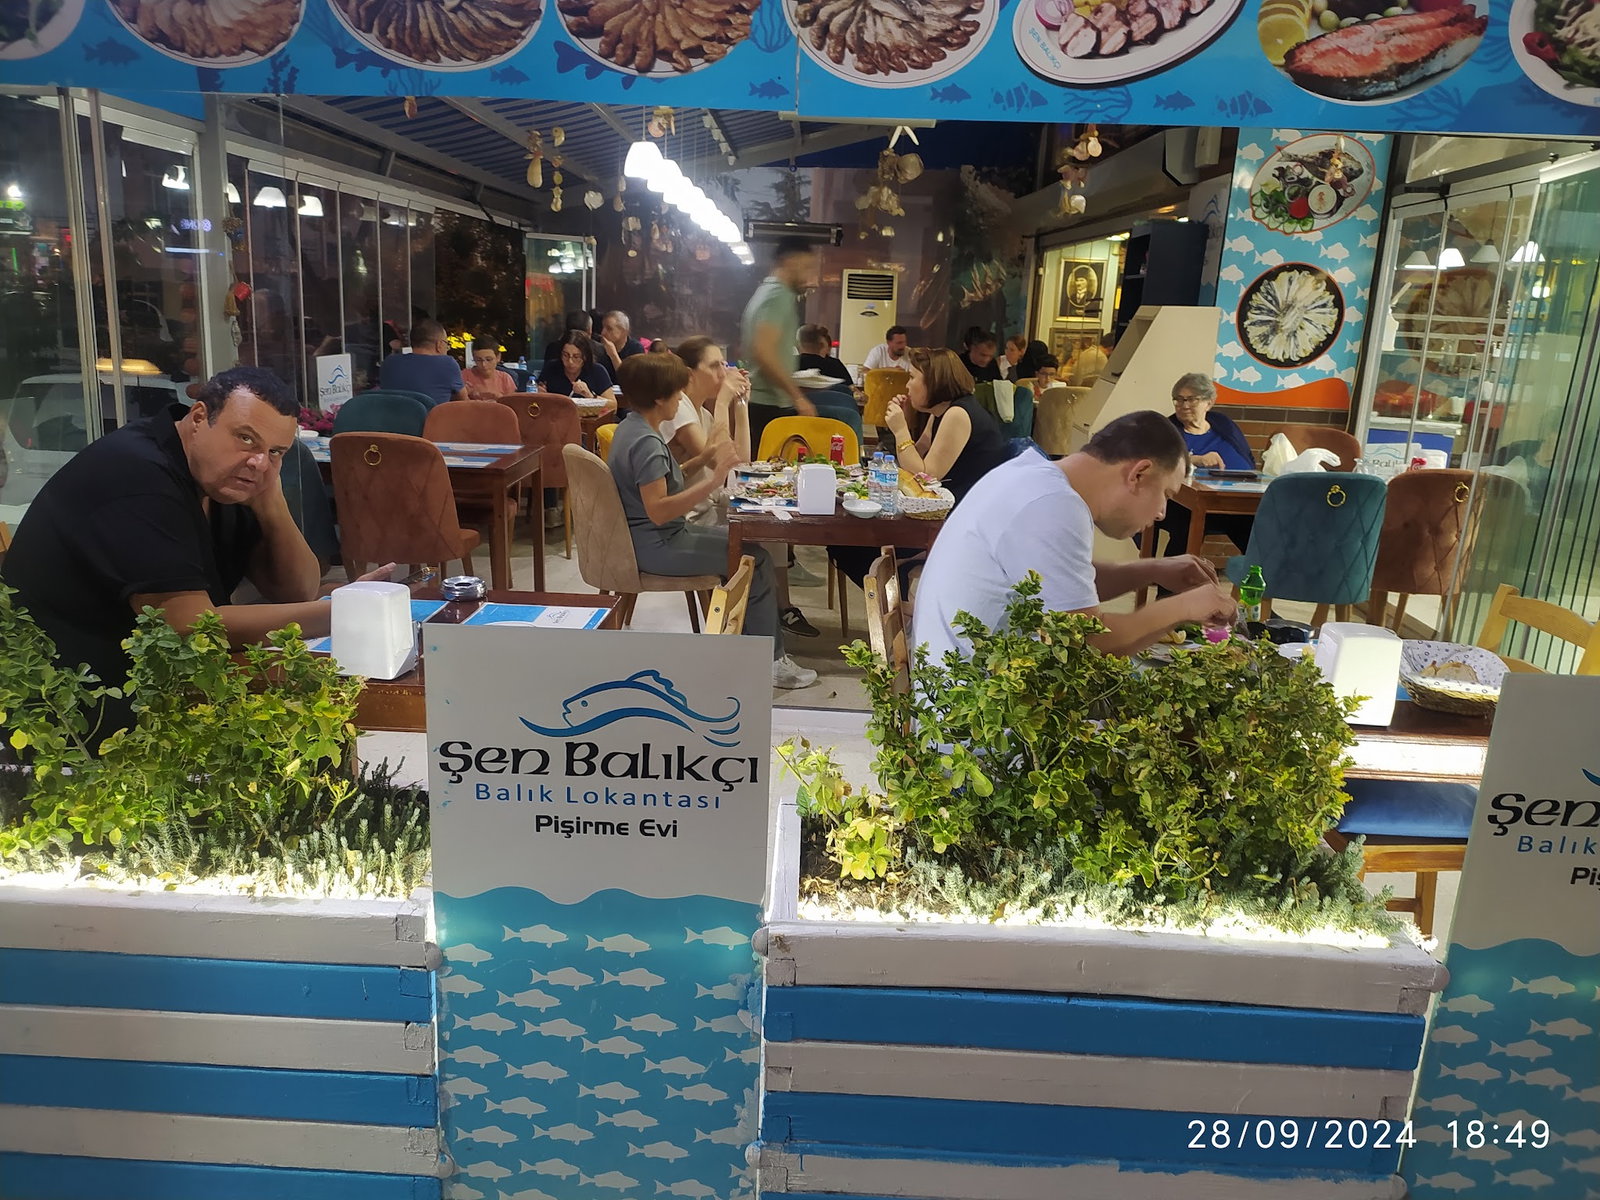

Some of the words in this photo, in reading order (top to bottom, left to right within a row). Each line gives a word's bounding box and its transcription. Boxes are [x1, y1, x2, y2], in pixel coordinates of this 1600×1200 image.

[438, 740, 551, 784] Şen
[564, 741, 759, 792] Balıkçı
[475, 783, 553, 803] Balık
[566, 786, 720, 809] Lokantası
[535, 814, 630, 839] Pişirme
[639, 818, 678, 838] Evi
[1487, 793, 1600, 836] Şen
[1517, 835, 1598, 855] Balık
